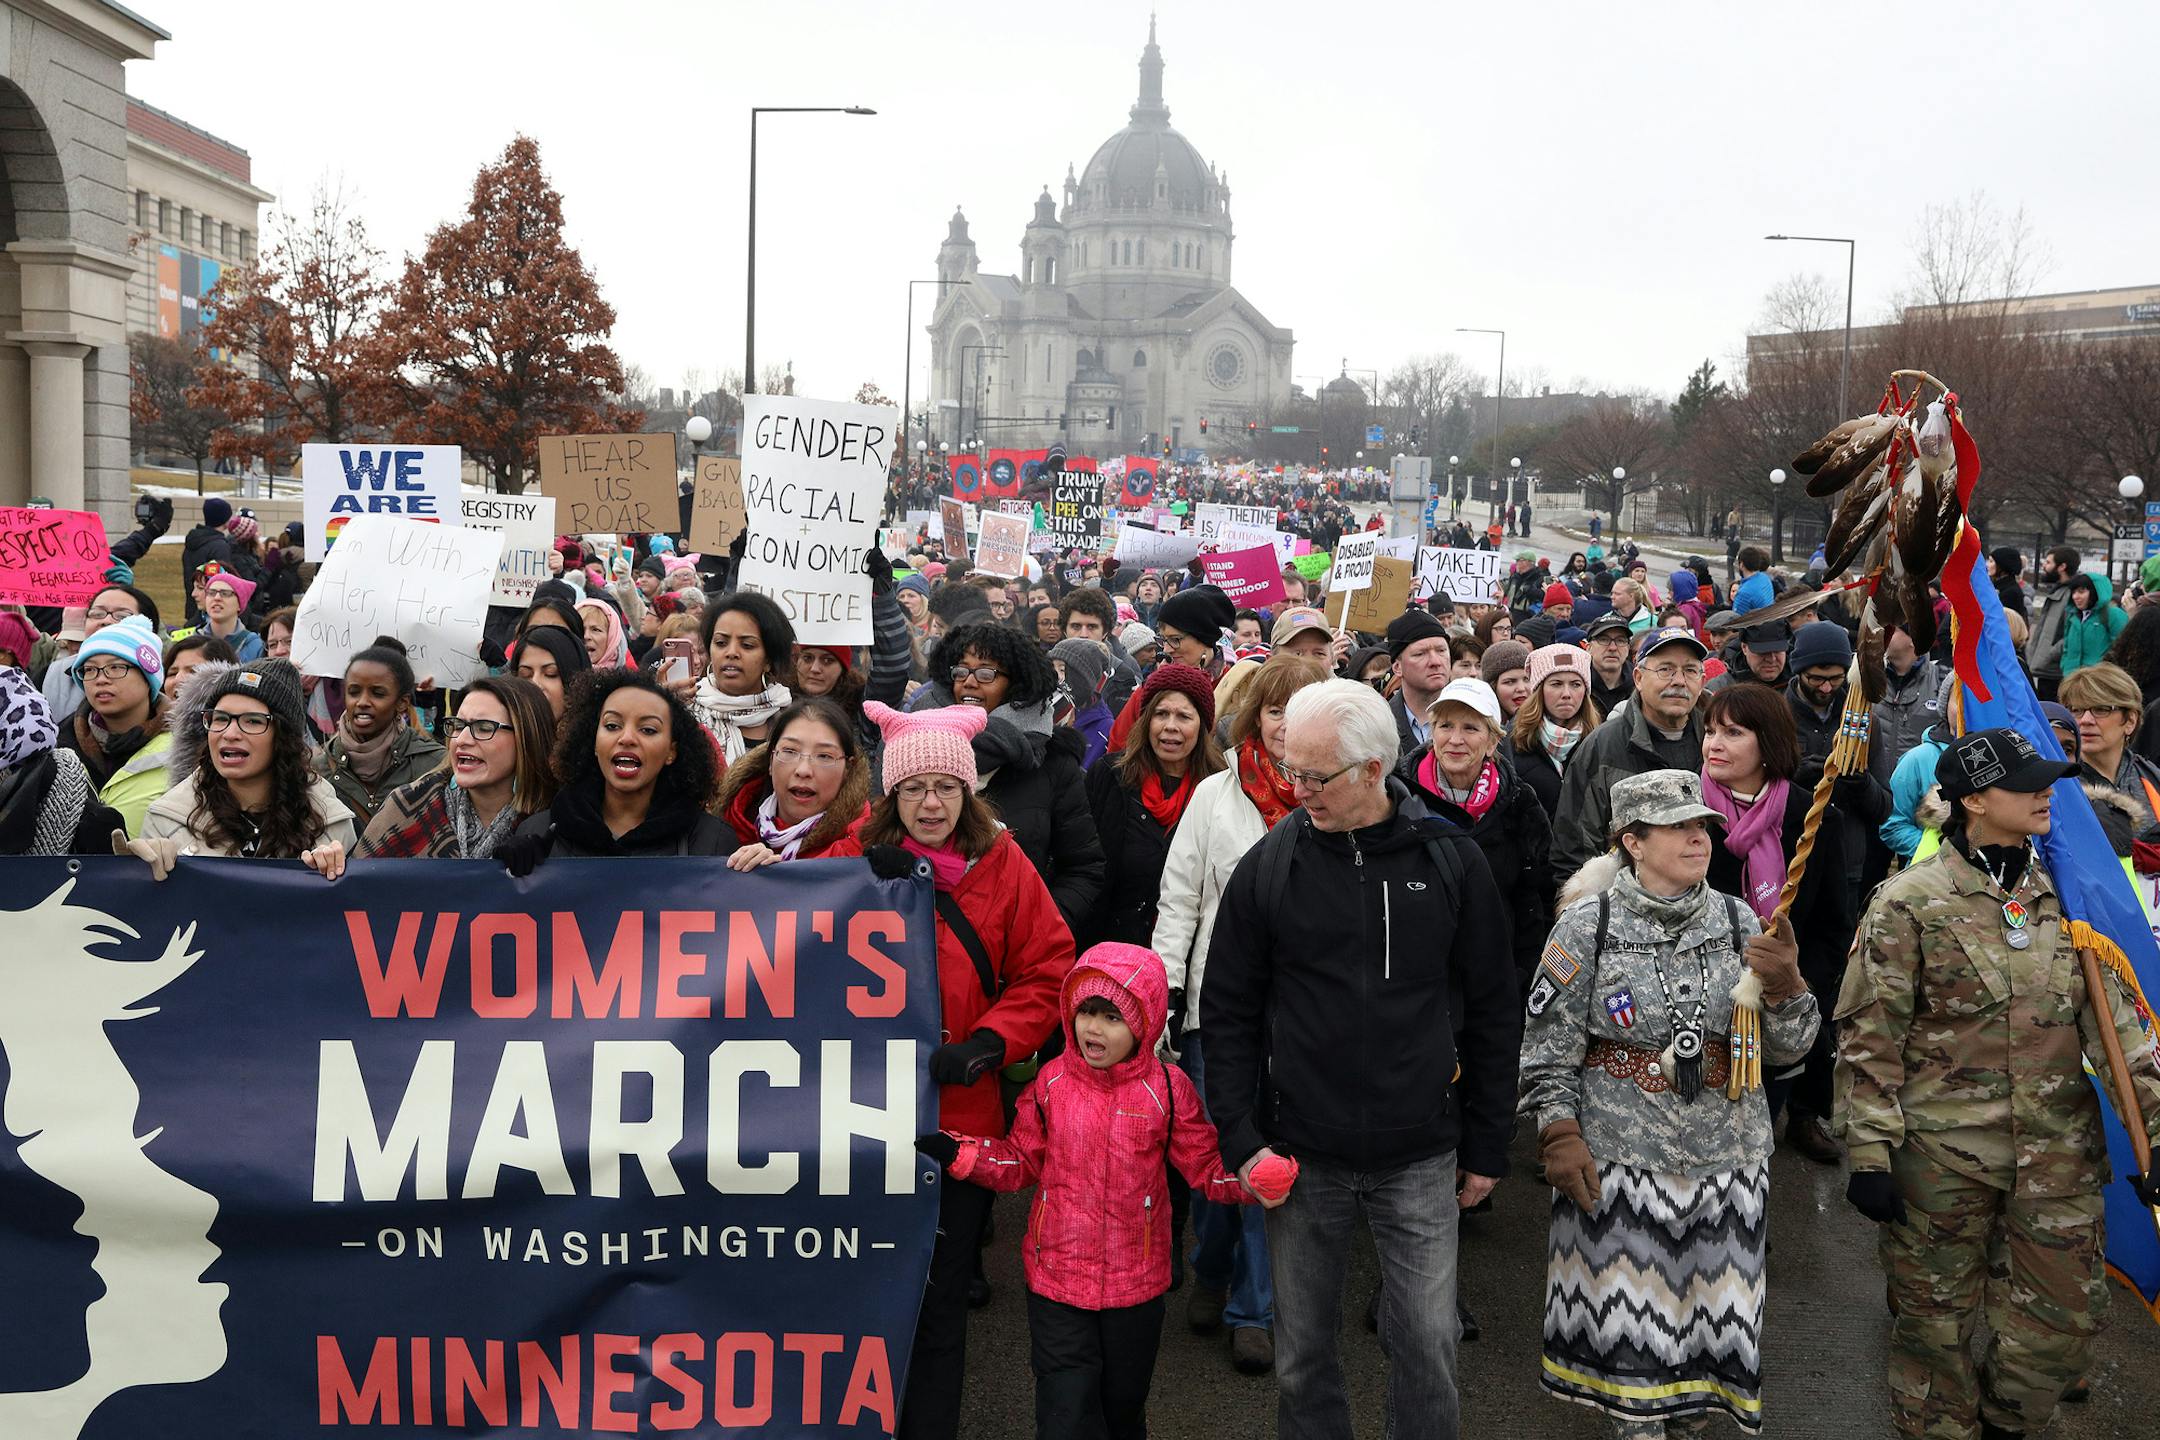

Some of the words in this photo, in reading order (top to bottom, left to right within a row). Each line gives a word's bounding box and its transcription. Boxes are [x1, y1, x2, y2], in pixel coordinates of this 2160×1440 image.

[562, 440, 649, 474] HEAR
[755, 415, 888, 473] GENDER,
[339, 450, 425, 491] WE
[1057, 471, 1104, 487] TRUMP
[595, 478, 632, 501] US
[747, 475, 864, 523] RACIAL
[1055, 487, 1098, 502] CAN'T
[330, 495, 437, 513] ARE
[571, 503, 655, 532] ROAR
[1055, 502, 1078, 517] PEE
[1083, 505, 1102, 519] ON
[1055, 516, 1086, 532] THIS
[2149, 524, 2160, 537] 9
[388, 527, 462, 573] With
[744, 532, 873, 574] CONOMIC
[1052, 532, 1100, 549] PARADE
[1338, 541, 1374, 561] DISABLED
[1335, 564, 1341, 579] &
[1344, 561, 1371, 579] PROUD
[1420, 549, 1475, 575] MAKE
[1482, 554, 1498, 576] IT
[30, 571, 94, 588] REGARLESS
[1418, 575, 1496, 598] NASTY
[395, 578, 452, 626] Her
[310, 621, 352, 648] and
[343, 910, 907, 1019] WOMEN'S
[311, 1039, 918, 1202] MARCH
[316, 1331, 897, 1433] MINNESOTA
